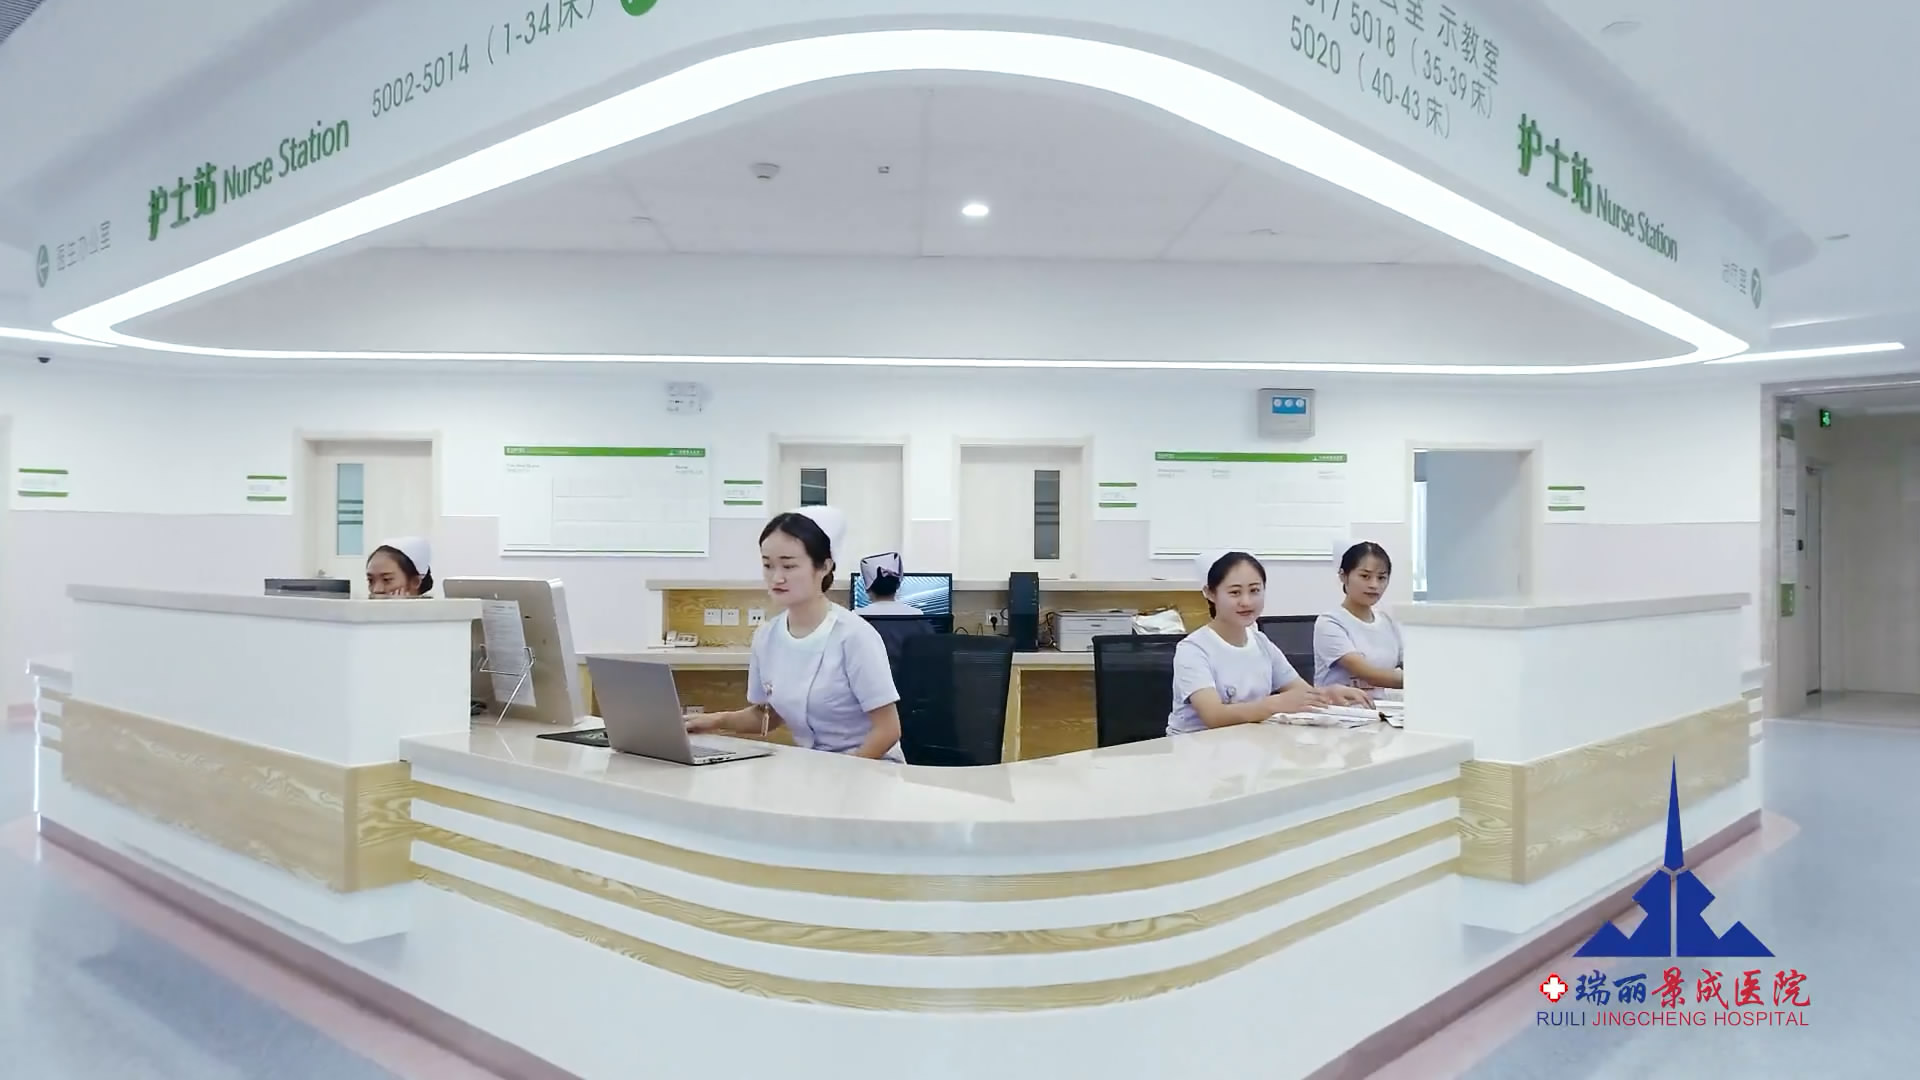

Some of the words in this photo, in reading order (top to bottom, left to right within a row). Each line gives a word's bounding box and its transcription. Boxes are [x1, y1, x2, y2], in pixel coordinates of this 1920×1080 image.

[1290, 15, 1341, 75] 5020
[1350, 2, 1396, 58] 5018
[1437, 4, 1499, 85] 示教室
[371, 43, 469, 117] 5002-5014
[148, 162, 217, 241] 护士站
[223, 156, 273, 204] Nurse
[278, 119, 350, 178] Station
[1517, 113, 1593, 214] 护士站
[1597, 184, 1634, 237] Nurse
[1638, 211, 1678, 262] Station
